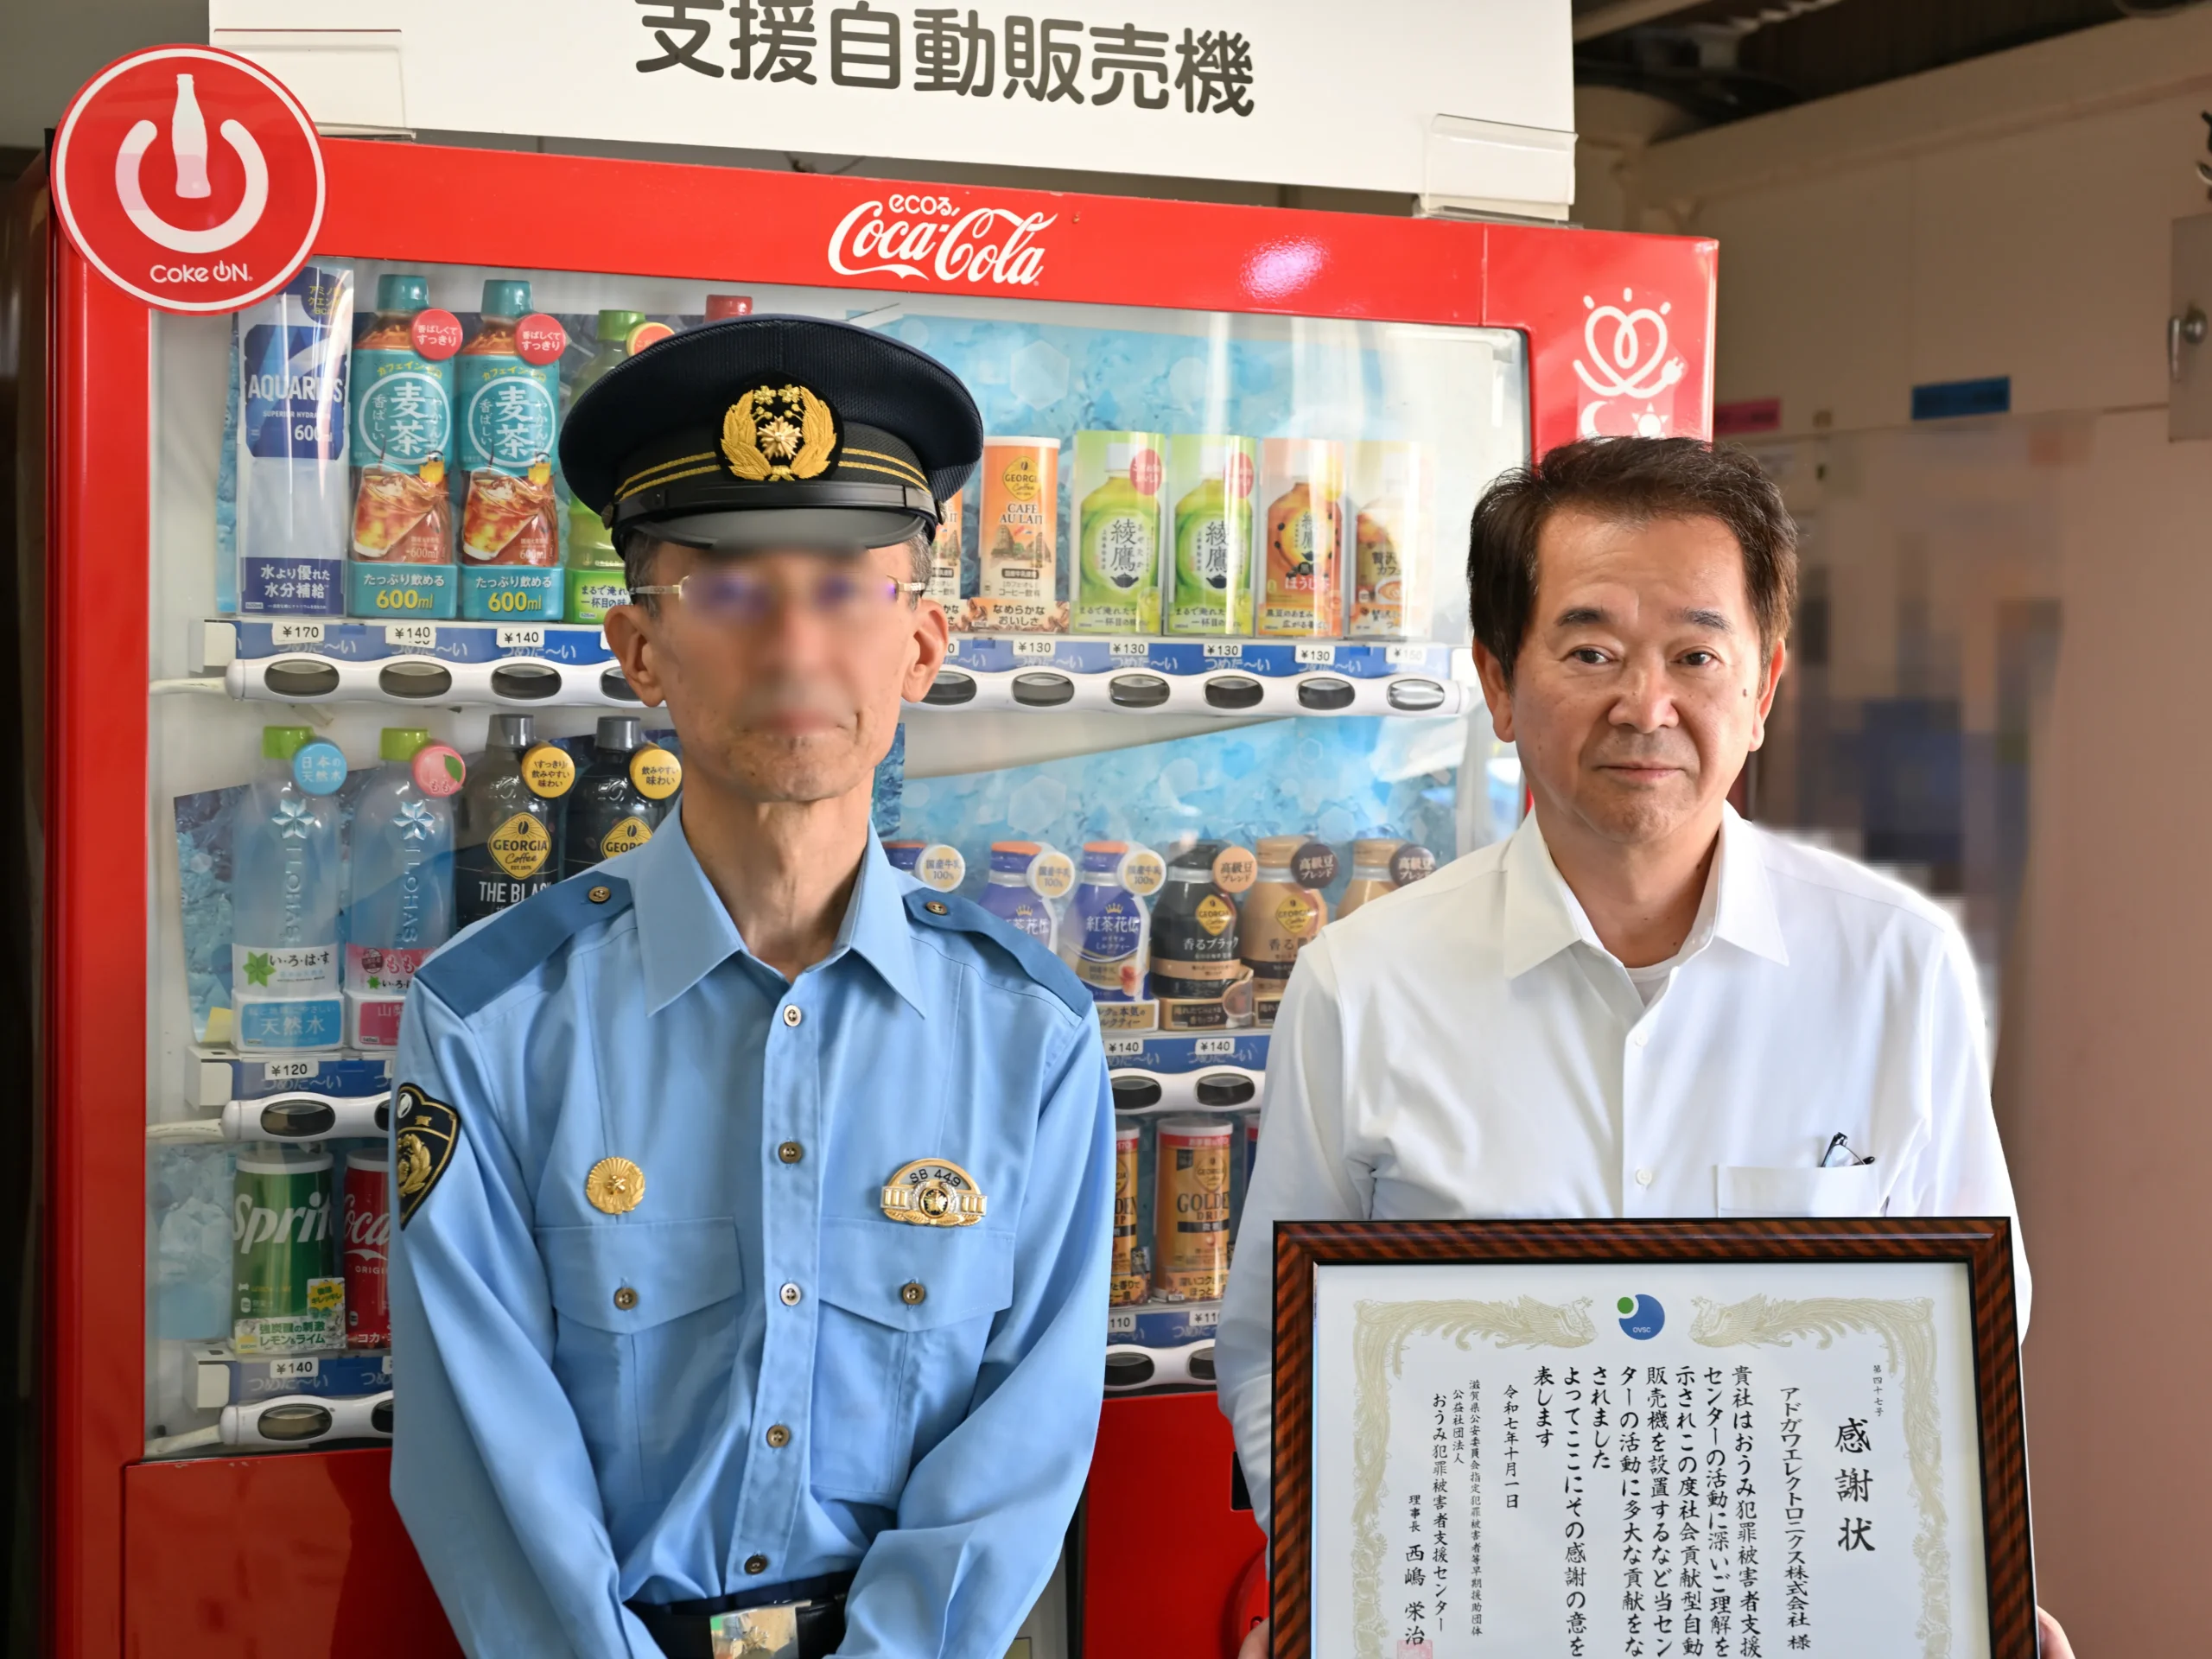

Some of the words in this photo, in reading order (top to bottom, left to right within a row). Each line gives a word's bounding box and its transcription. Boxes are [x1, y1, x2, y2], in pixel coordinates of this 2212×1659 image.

[635, 0, 1255, 117] 支援自動販売機
[828, 200, 1058, 286] Coca-Cola
[149, 264, 209, 283] Coke
[417, 325, 458, 335] 香ばしくて
[522, 330, 562, 340] 香ばしくて
[416, 334, 457, 346] すっきり
[522, 340, 561, 351] すっきり
[372, 393, 388, 442] 香ばしい
[387, 381, 429, 455] 麦茶
[479, 399, 493, 446] 香ばしい
[493, 385, 535, 459] 麦茶
[1004, 474, 1040, 483] GEORGI
[1000, 513, 1017, 524] AU
[1018, 514, 1043, 524] LAIT
[1110, 518, 1137, 572] 綾鷹
[260, 563, 331, 581] 水より優れた
[364, 573, 445, 587] たっぷり飲める
[475, 575, 553, 588] たっぷり飲める
[264, 582, 326, 599] 水分補給
[582, 584, 629, 596] まるで淹れ
[376, 589, 434, 609] 600ml
[488, 591, 543, 612] 600ml
[993, 604, 1046, 616] なめらかな
[998, 615, 1039, 627] おいしさ
[283, 626, 320, 638] ¥170
[395, 626, 431, 639] ¥140
[504, 632, 539, 644] ¥140
[1018, 642, 1052, 653] ¥130
[1113, 644, 1145, 654] ¥130
[1207, 645, 1239, 656] ¥130
[1300, 649, 1331, 662] ¥130
[302, 756, 342, 769] 日本の
[301, 769, 342, 783] 天然水
[531, 770, 570, 779] 飲みやすい
[641, 766, 680, 776] 飲みやすい
[537, 779, 563, 788] 味わい
[645, 776, 675, 785] 味わい
[493, 839, 548, 852] GEORGIA
[505, 852, 537, 865] Coffee
[925, 858, 962, 870] 国産牛乳
[1300, 855, 1334, 871] 高級豆
[1398, 855, 1433, 871] 高級豆
[932, 869, 954, 880] 100%
[1038, 867, 1071, 878] 国産牛乳
[1128, 865, 1161, 876] 国産牛乳
[1219, 861, 1253, 874] 高級豆
[1134, 875, 1155, 886] 100%
[1221, 874, 1251, 884] ブレンド
[1300, 870, 1333, 881] ブレンド
[1043, 878, 1064, 888] 100%
[479, 881, 508, 904] THE
[1006, 917, 1050, 935] 茶花伝
[1086, 915, 1140, 933] 紅茶花伝
[1184, 936, 1239, 950] 香るブラック
[386, 954, 416, 974] もも
[261, 1015, 326, 1037] 天然水
[1109, 1042, 1140, 1052] ¥140
[1200, 1041, 1230, 1052] ¥140
[270, 1064, 308, 1077] ¥120
[909, 1168, 929, 1184] SB
[934, 1168, 962, 1187] 449
[1177, 1191, 1230, 1213] GOLDE
[232, 1191, 334, 1255] Sprit
[1109, 1317, 1131, 1328] 110
[1195, 1313, 1219, 1323] ¥11
[259, 1321, 326, 1335] 強炭酸の刺激
[276, 1361, 313, 1374] ¥140
[1872, 1364, 1885, 1417] 第四十七号
[1534, 1365, 1555, 1448] 表します
[1591, 1366, 1611, 1470] されました
[1452, 1389, 1465, 1465] 公益社団法人
[1503, 1384, 1520, 1510] 令和七年十月一日
[1834, 1417, 1877, 1552] 感謝状
[1408, 1495, 1421, 1533] 理事長
[1433, 1394, 1449, 1632] おうみ犯罪被害者支援センター
[1468, 1379, 1484, 1637] 滋賀県公安委員会指定犯罪被害者等早期援助団体
[1564, 1366, 1587, 1657] よってここにその感謝の意を
[1619, 1366, 1645, 1657] ターの活動に多大な貢献をな
[1646, 1366, 1674, 1657] 販売機を設置するなど当セン
[1676, 1366, 1705, 1656] 示されこの度社会貢献型自動
[1704, 1366, 1732, 1658] センターの活動に深いご理解を
[1732, 1365, 1763, 1659] 貴社はおうみ犯罪被害者支援
